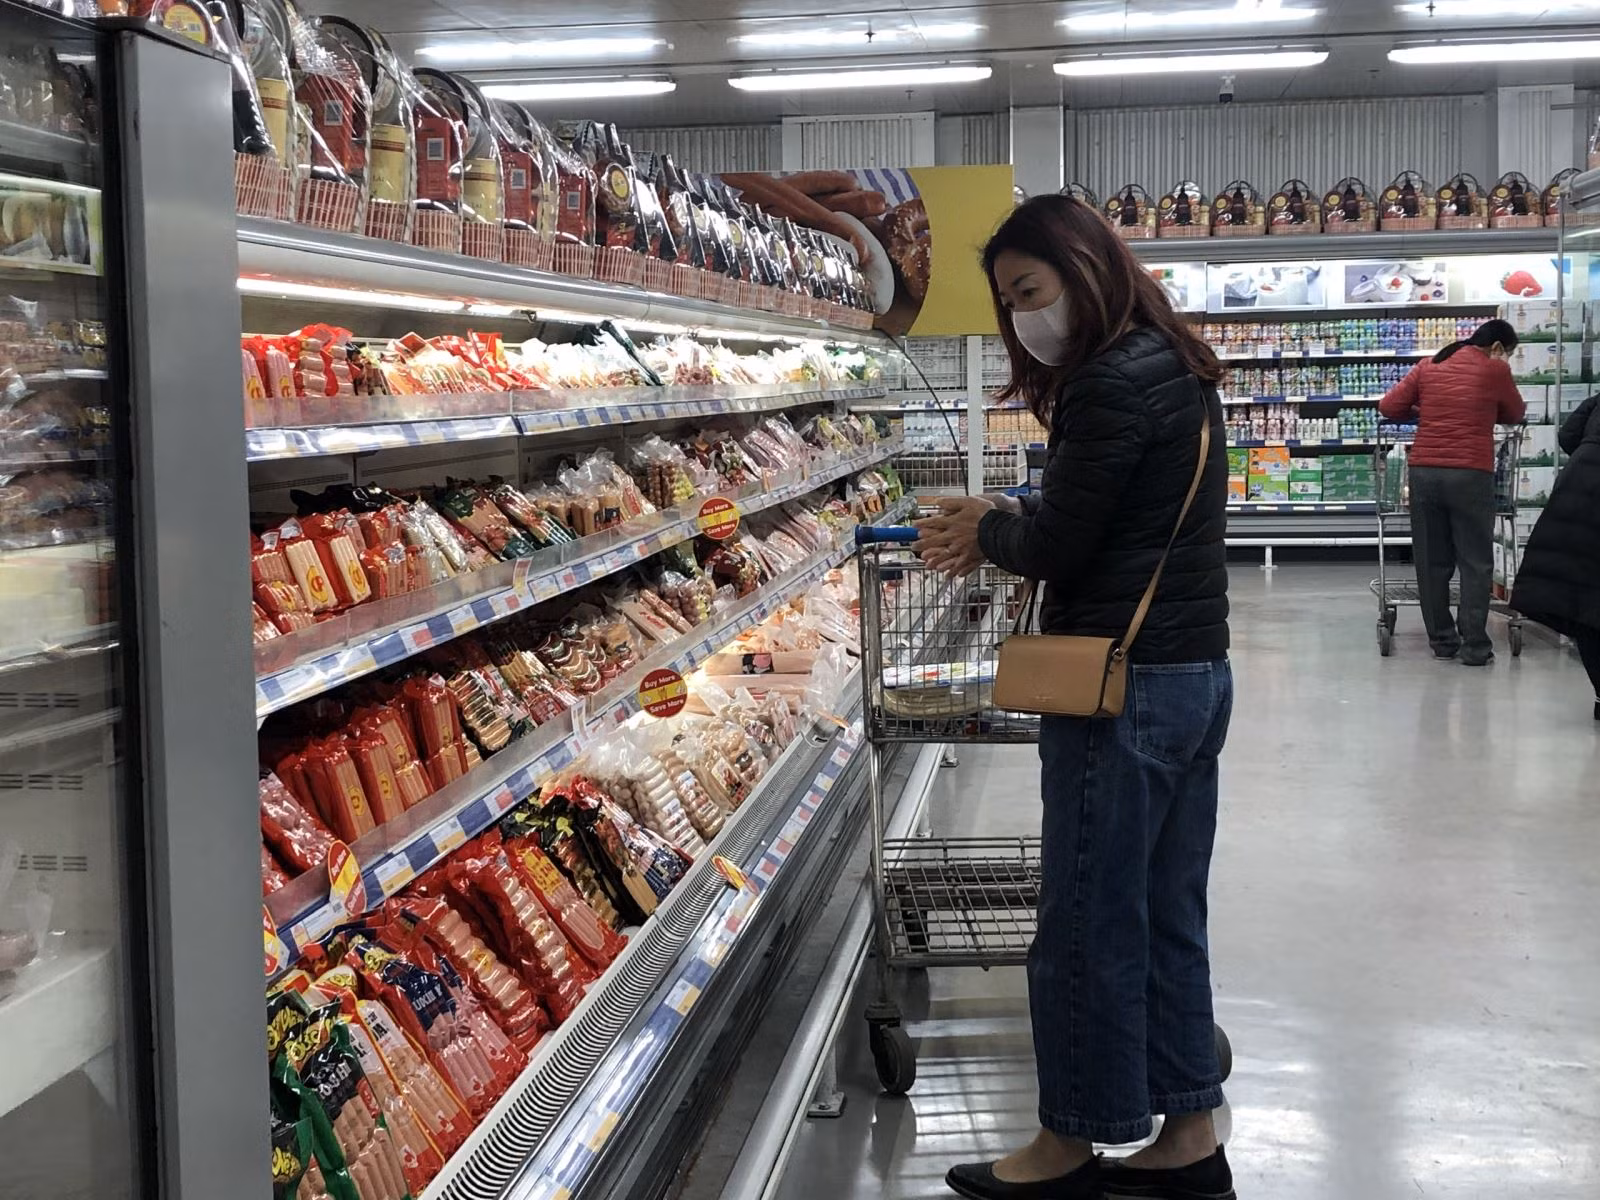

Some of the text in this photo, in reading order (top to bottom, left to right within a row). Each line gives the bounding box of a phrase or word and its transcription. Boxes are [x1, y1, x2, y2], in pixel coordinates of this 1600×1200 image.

[702, 503, 729, 515] Buy More
[706, 527, 721, 535] Save
[644, 674, 676, 689] Buy More
[650, 699, 684, 713] Save More
